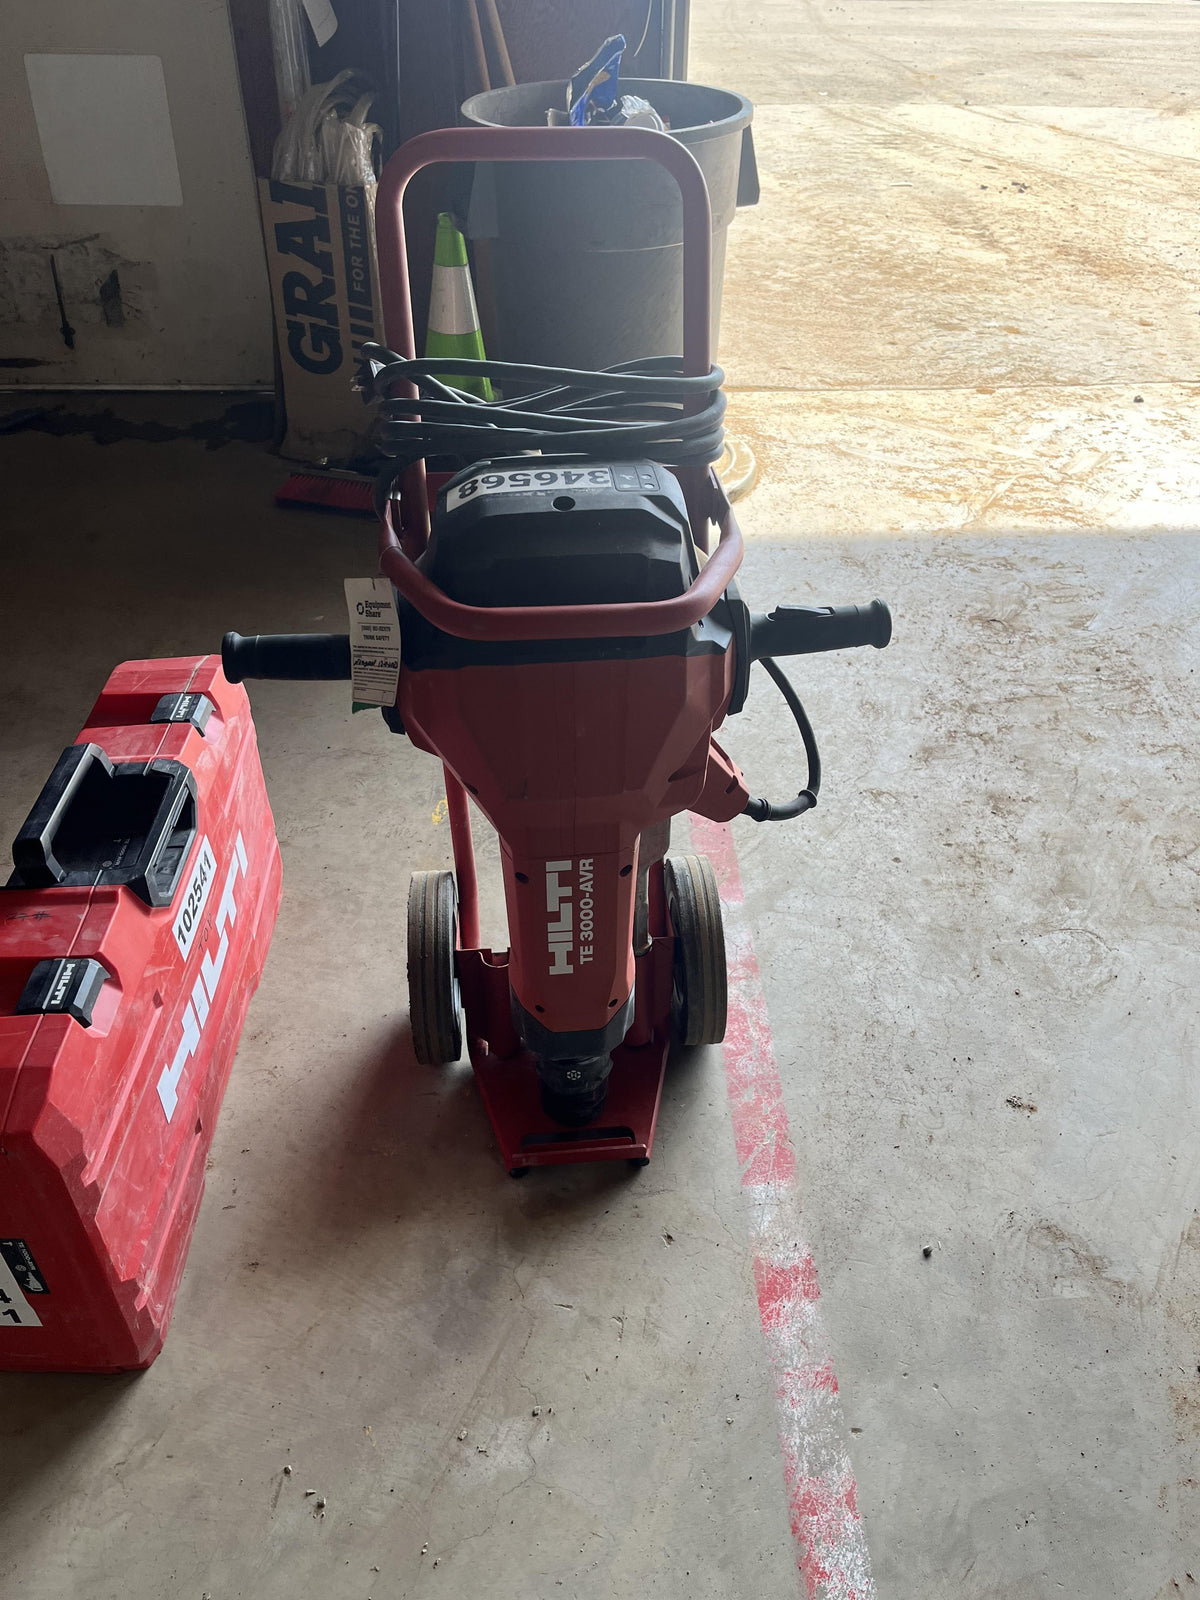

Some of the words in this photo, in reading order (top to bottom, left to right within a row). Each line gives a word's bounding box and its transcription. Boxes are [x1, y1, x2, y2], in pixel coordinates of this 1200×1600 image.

[349, 214, 361, 249] THE
[352, 256, 365, 292] FOR
[458, 470, 610, 499] 346568
[365, 610, 381, 618] Share
[176, 695, 192, 718] HILTI
[177, 850, 212, 945] 102541
[579, 858, 594, 941] 3000-AVR
[545, 859, 574, 975] HILTI
[579, 945, 594, 964] TE
[51, 963, 76, 1005] HILTI
[156, 829, 249, 1124] HILTI
